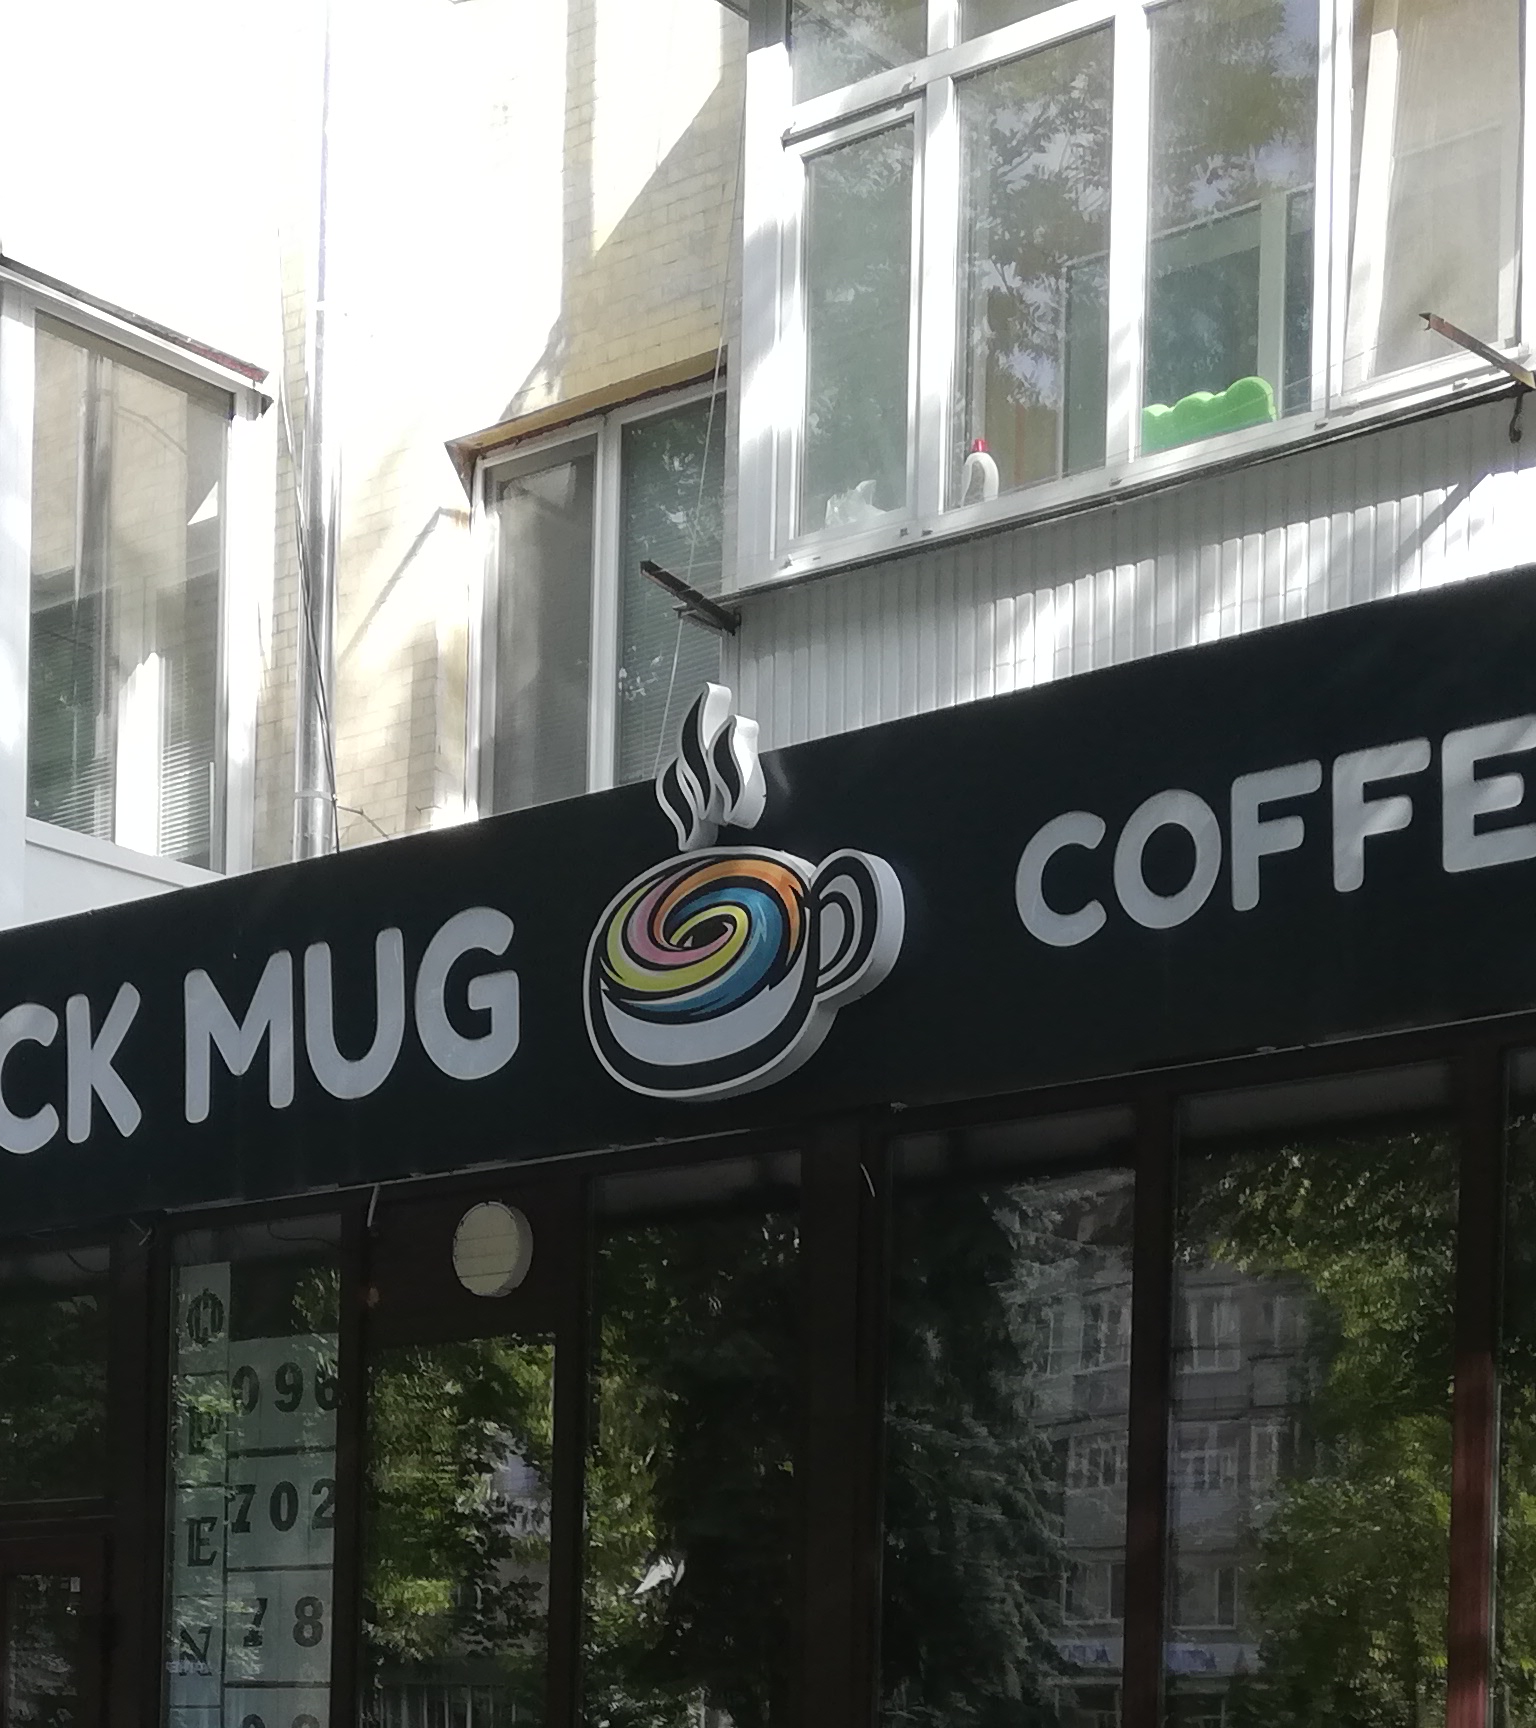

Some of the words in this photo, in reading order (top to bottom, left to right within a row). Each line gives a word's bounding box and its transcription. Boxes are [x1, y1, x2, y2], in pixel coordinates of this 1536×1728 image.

[183, 906, 519, 1126] MUG
[232, 1362, 337, 1417] 096
[228, 1478, 336, 1534] 702
